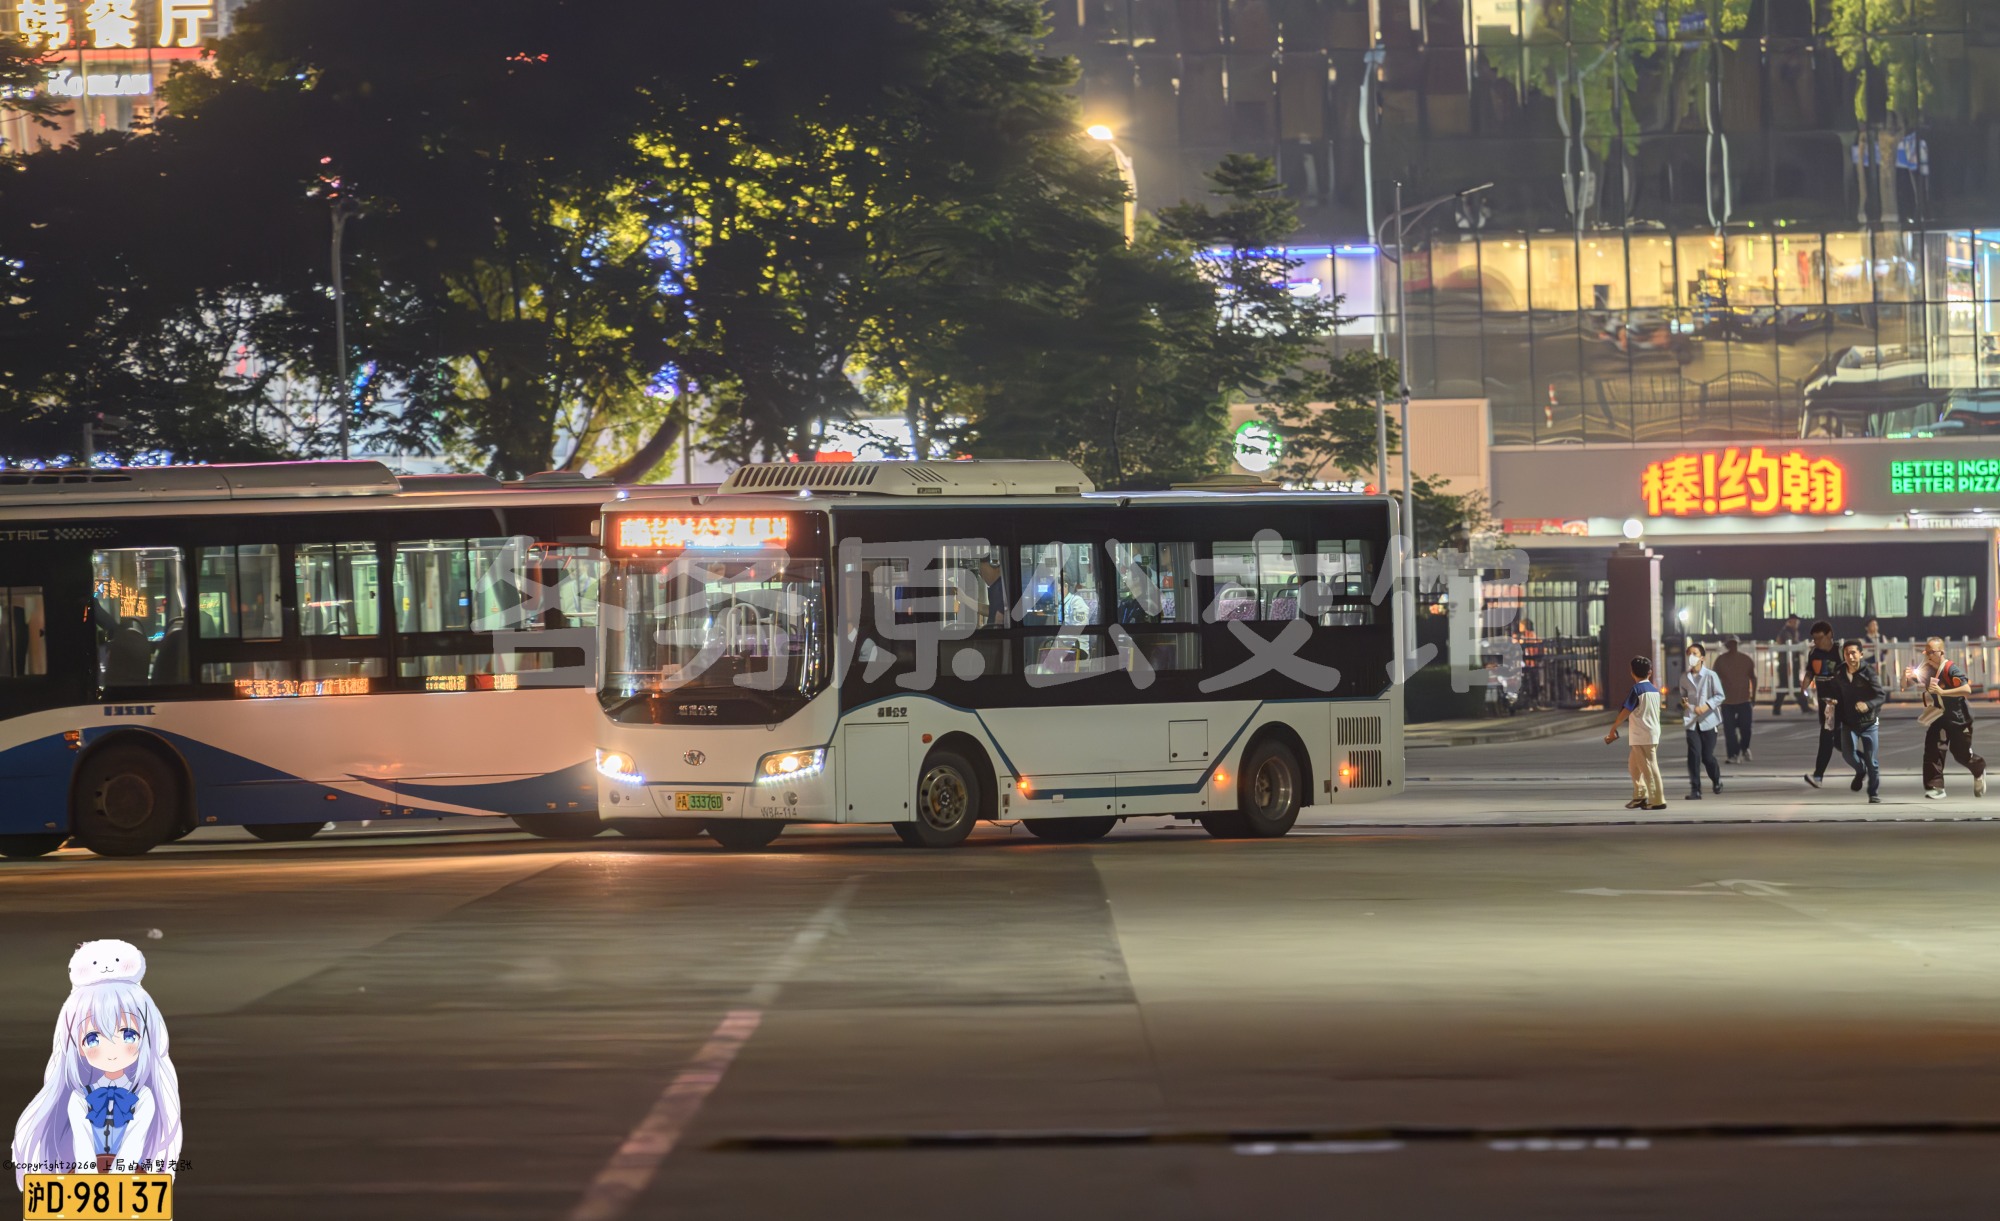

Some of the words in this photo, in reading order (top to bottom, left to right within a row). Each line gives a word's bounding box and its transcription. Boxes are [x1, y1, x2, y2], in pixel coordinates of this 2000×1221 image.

[1891, 460, 1955, 477] BETTER
[1958, 460, 2000, 476] INGR
[1642, 446, 1847, 517] 棒!约翰
[1891, 477, 1955, 494] BETTER
